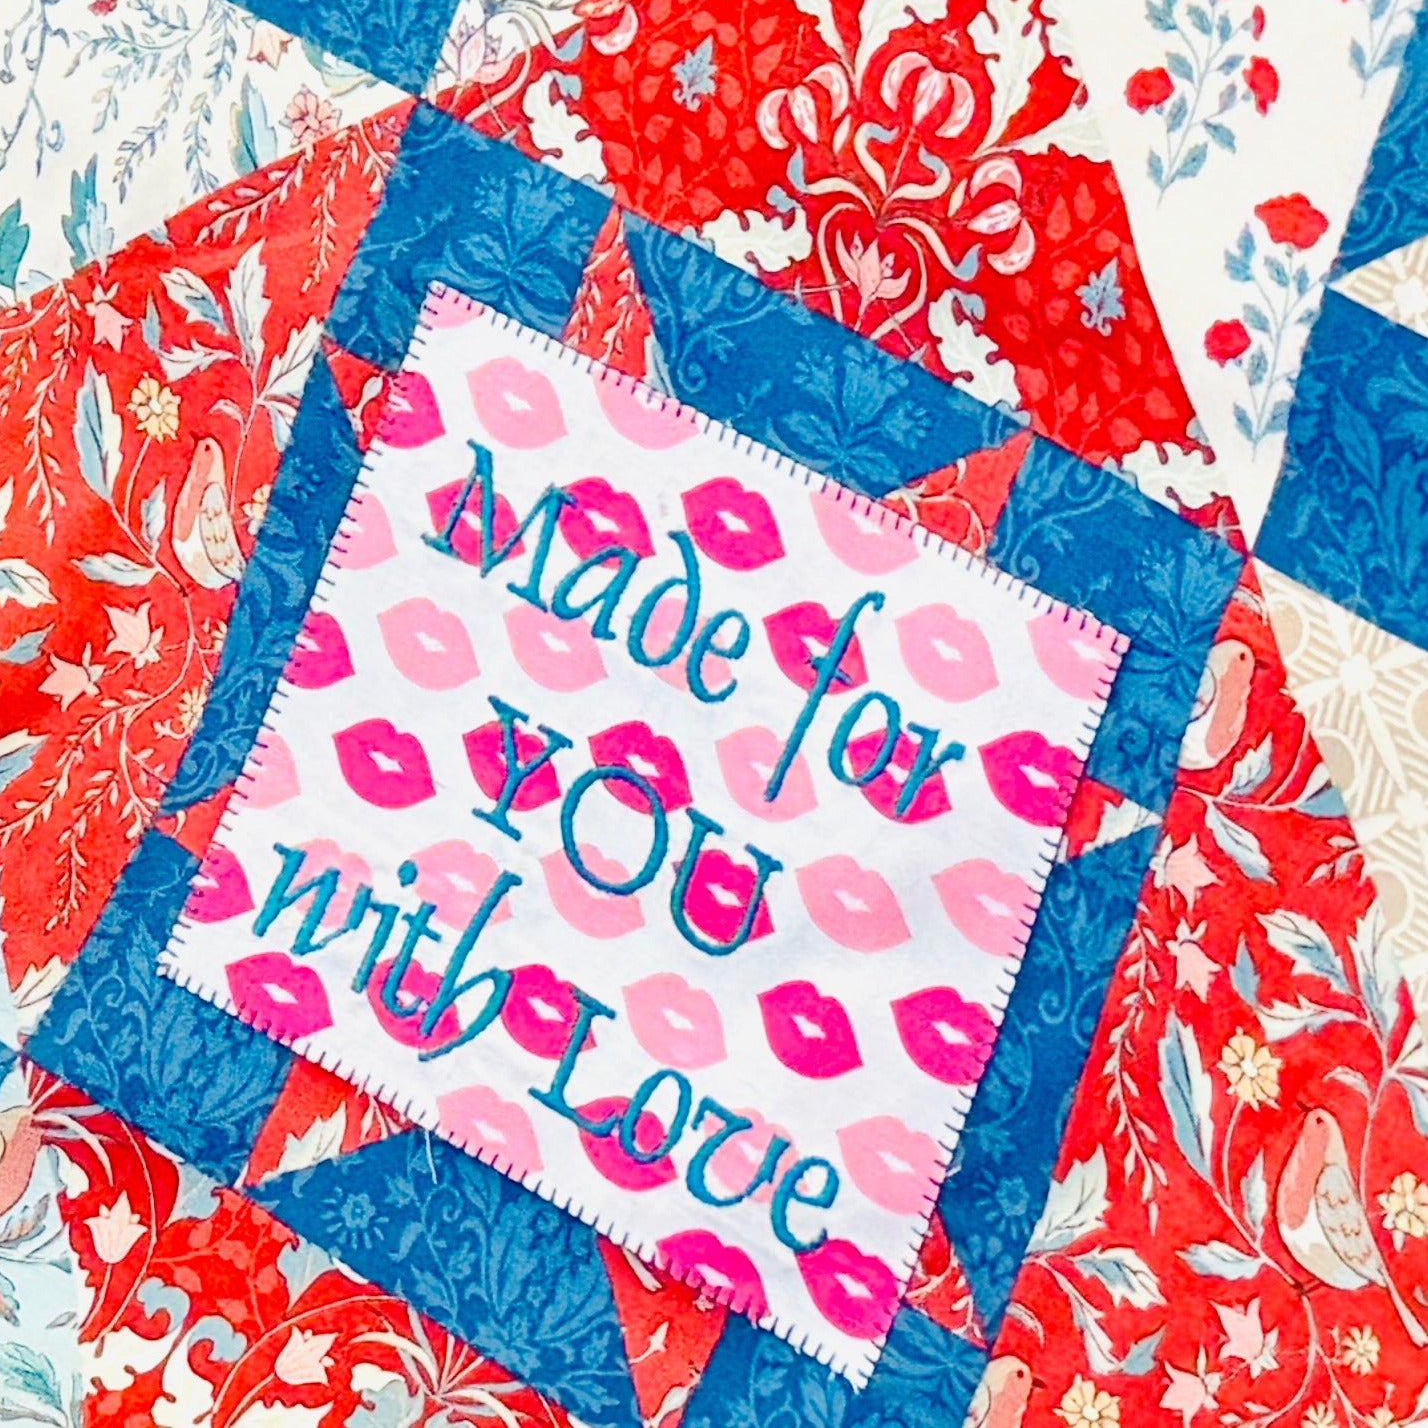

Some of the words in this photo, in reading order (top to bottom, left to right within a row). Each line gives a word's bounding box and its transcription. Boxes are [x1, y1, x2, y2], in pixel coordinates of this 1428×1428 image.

[420, 439, 751, 704] Made
[763, 590, 967, 820] for
[471, 694, 784, 957] YOU
[251, 842, 523, 1063] with
[527, 986, 841, 1254] Love
